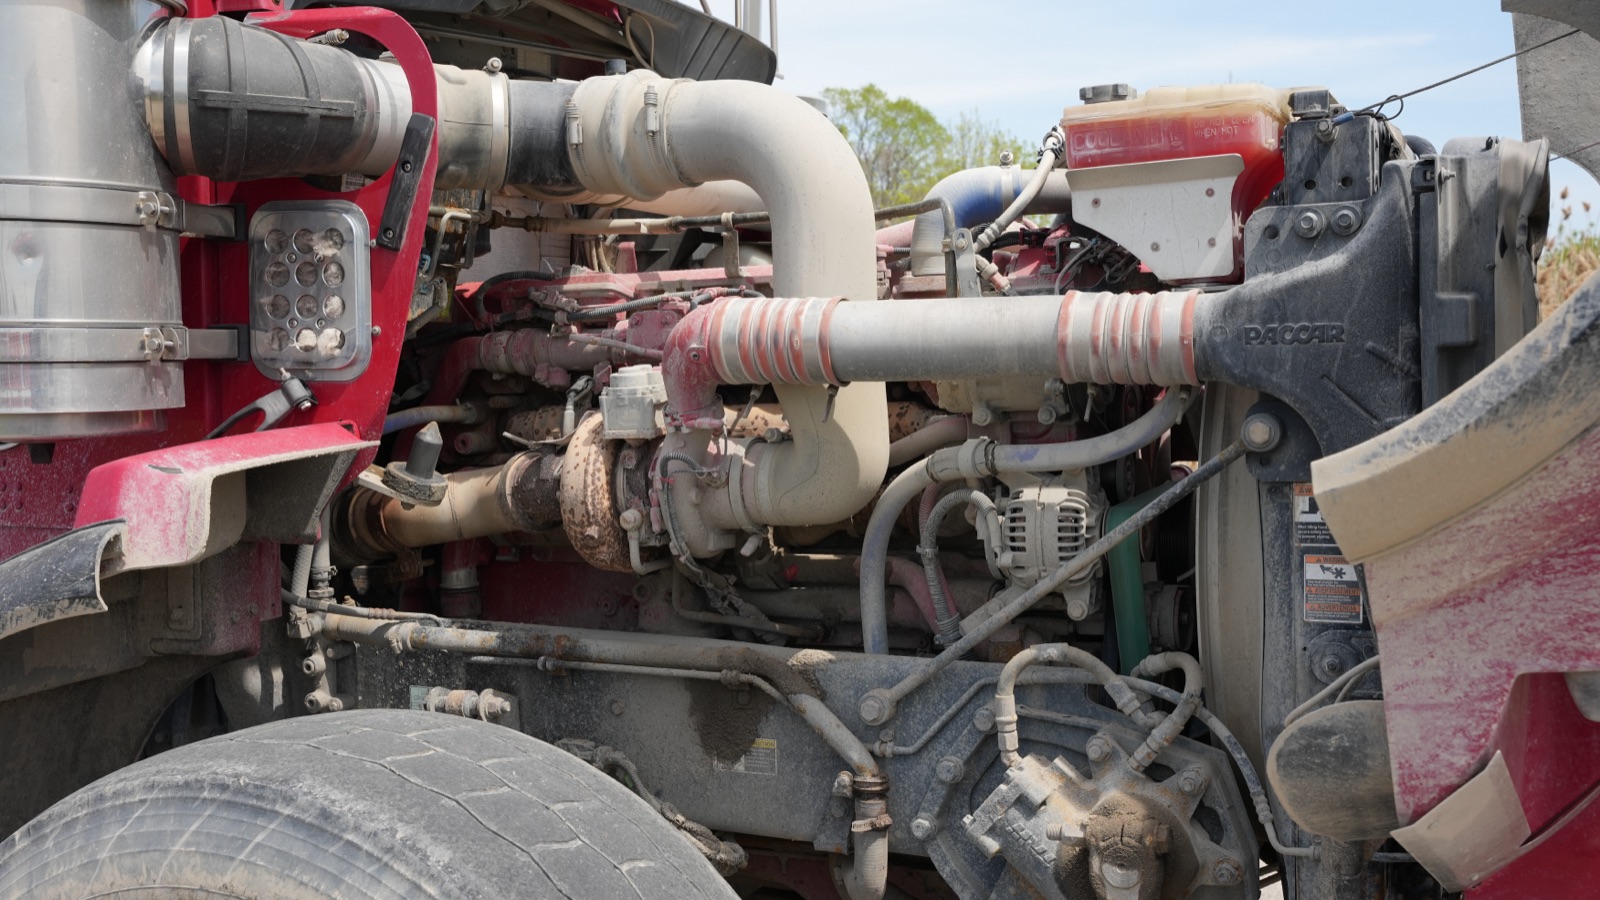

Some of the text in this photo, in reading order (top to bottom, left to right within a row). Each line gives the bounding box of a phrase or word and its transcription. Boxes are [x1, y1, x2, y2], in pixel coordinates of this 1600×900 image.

[1210, 118, 1225, 127] NOT
[1232, 115, 1255, 125] OPEN
[1073, 126, 1159, 150] COOLANT
[1194, 126, 1239, 138] WHEN HOT
[1244, 322, 1345, 346] PACCAR
[1314, 587, 1360, 595] AVERTISSEMENT
